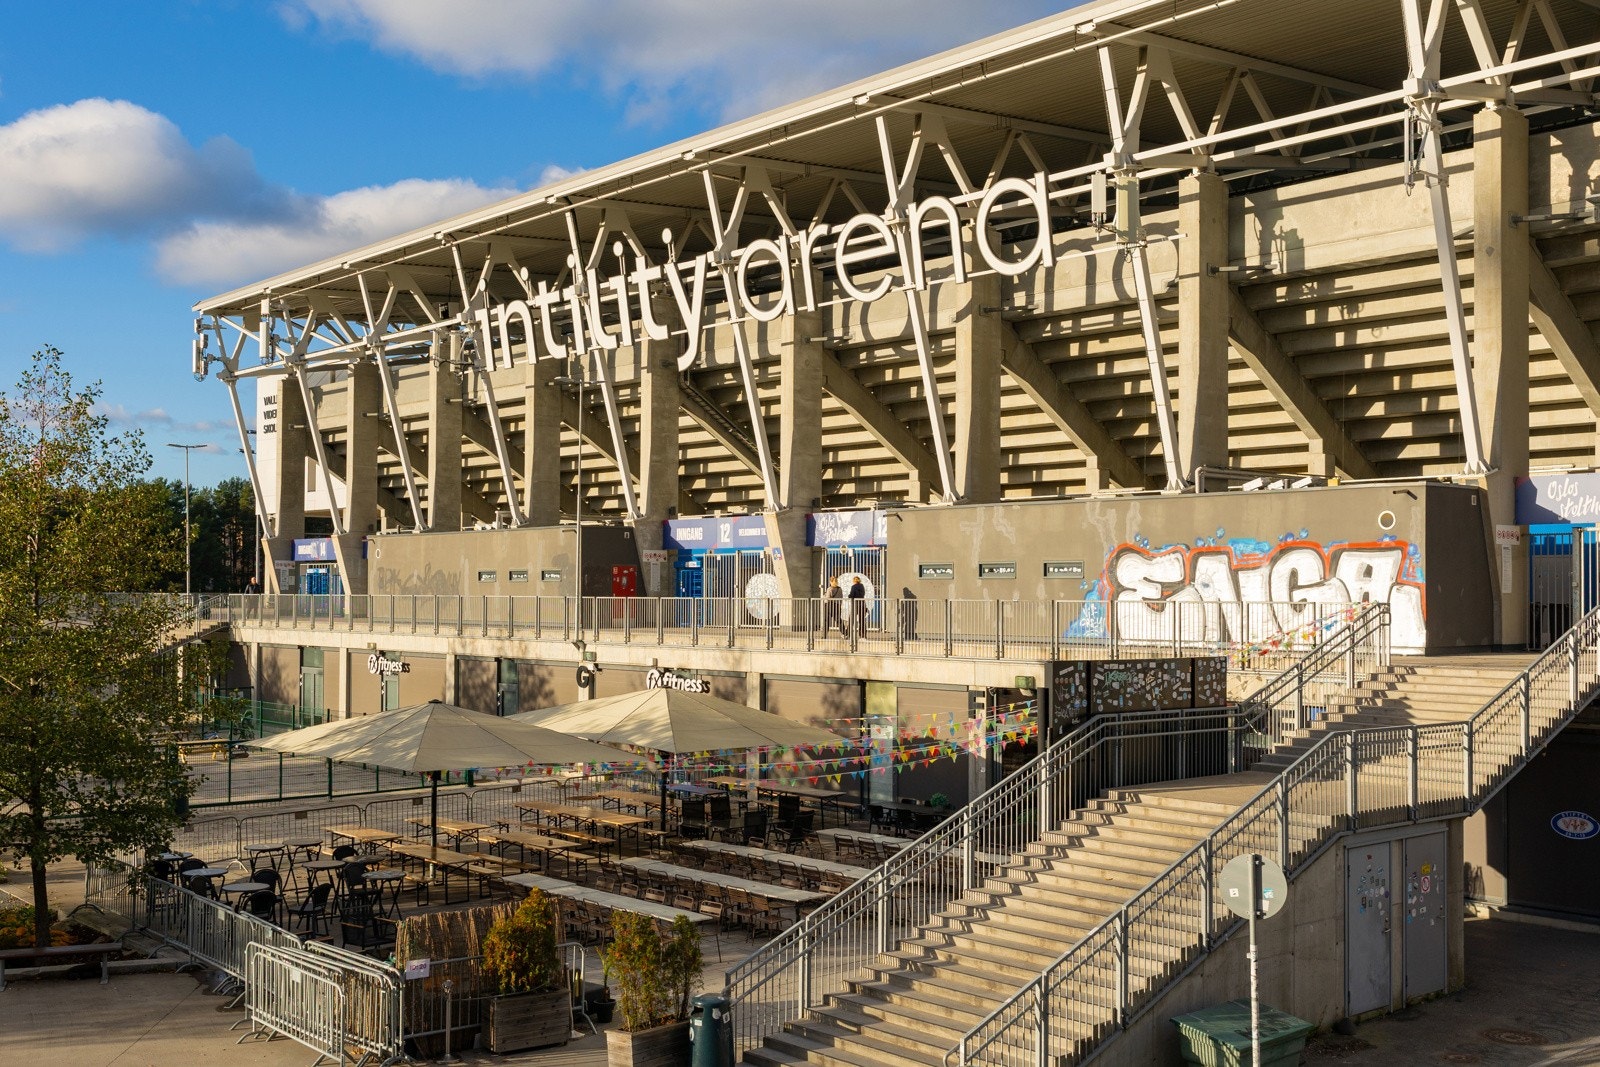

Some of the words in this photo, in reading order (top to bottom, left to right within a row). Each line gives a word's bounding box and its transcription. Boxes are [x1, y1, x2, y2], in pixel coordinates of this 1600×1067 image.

[475, 228, 707, 372] intility
[737, 171, 1054, 322] arena
[1547, 477, 1578, 501] Oslos
[1557, 495, 1600, 520] stolth
[676, 527, 703, 541] INNGANG
[720, 523, 730, 543] 12
[377, 655, 402, 675] fitness
[576, 666, 590, 688] G
[663, 672, 703, 693] fitness
[968, 690, 985, 719] F
